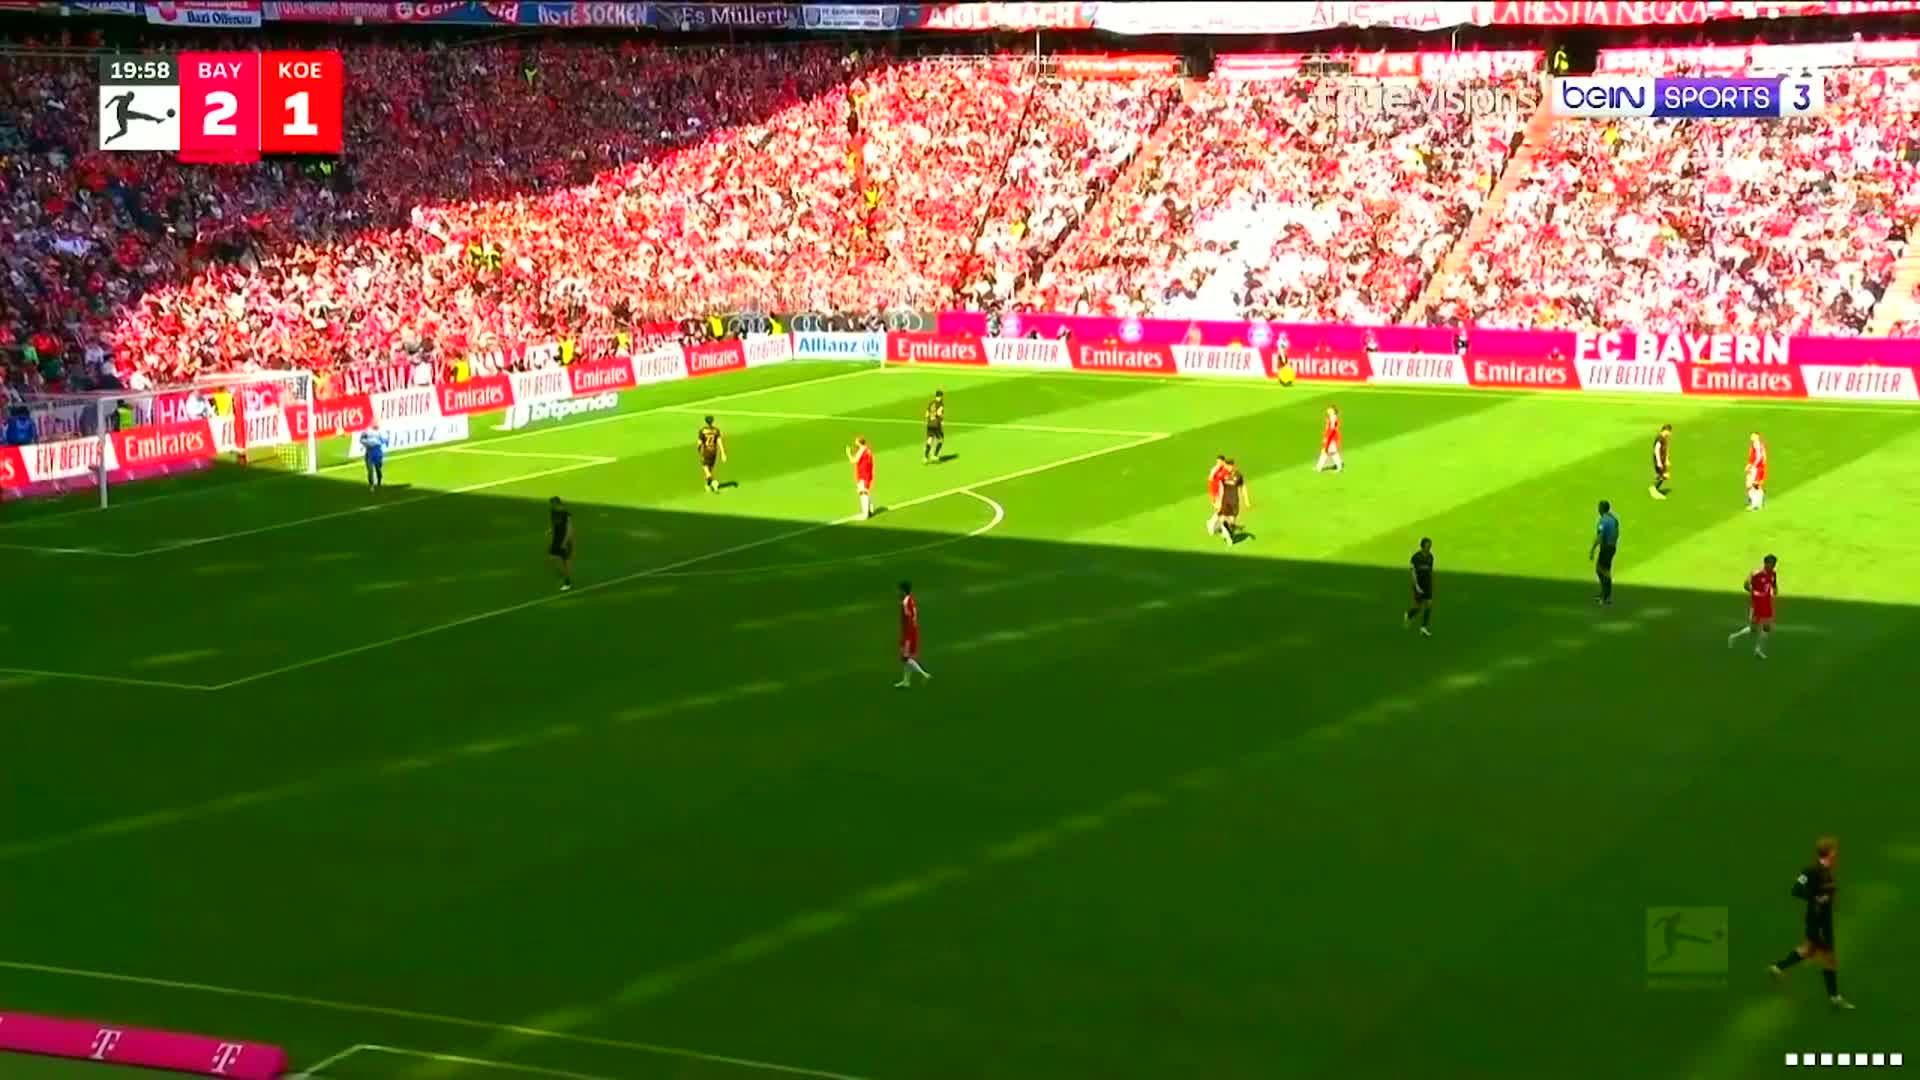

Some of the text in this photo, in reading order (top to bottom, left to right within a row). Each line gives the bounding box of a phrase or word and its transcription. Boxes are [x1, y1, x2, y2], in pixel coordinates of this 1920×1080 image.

[581, 3, 648, 26] SOCKEN
[1310, 2, 1440, 26] AUSRIA
[1523, 2, 1609, 25] BESTIA
[798, 337, 858, 352] Allianz
[897, 338, 977, 361] Emirates
[994, 342, 1059, 363] FLY BETTER
[1577, 332, 1790, 364] FC BAYERN
[691, 350, 739, 371] Emirates
[1080, 345, 1163, 369] Emirates
[1184, 348, 1252, 371] FLY BETTER
[1382, 357, 1453, 378] FLY BETTER
[574, 366, 628, 389] Emirates
[1475, 361, 1567, 384] Emirates
[1589, 365, 1666, 386] FLY BETTER
[1691, 367, 1792, 392] Emirates
[1817, 370, 1901, 393] FLY BETTER
[444, 386, 505, 411] Emirates
[125, 430, 205, 461] Emirates
[90, 1028, 121, 1060] T
[211, 1041, 243, 1073] T
